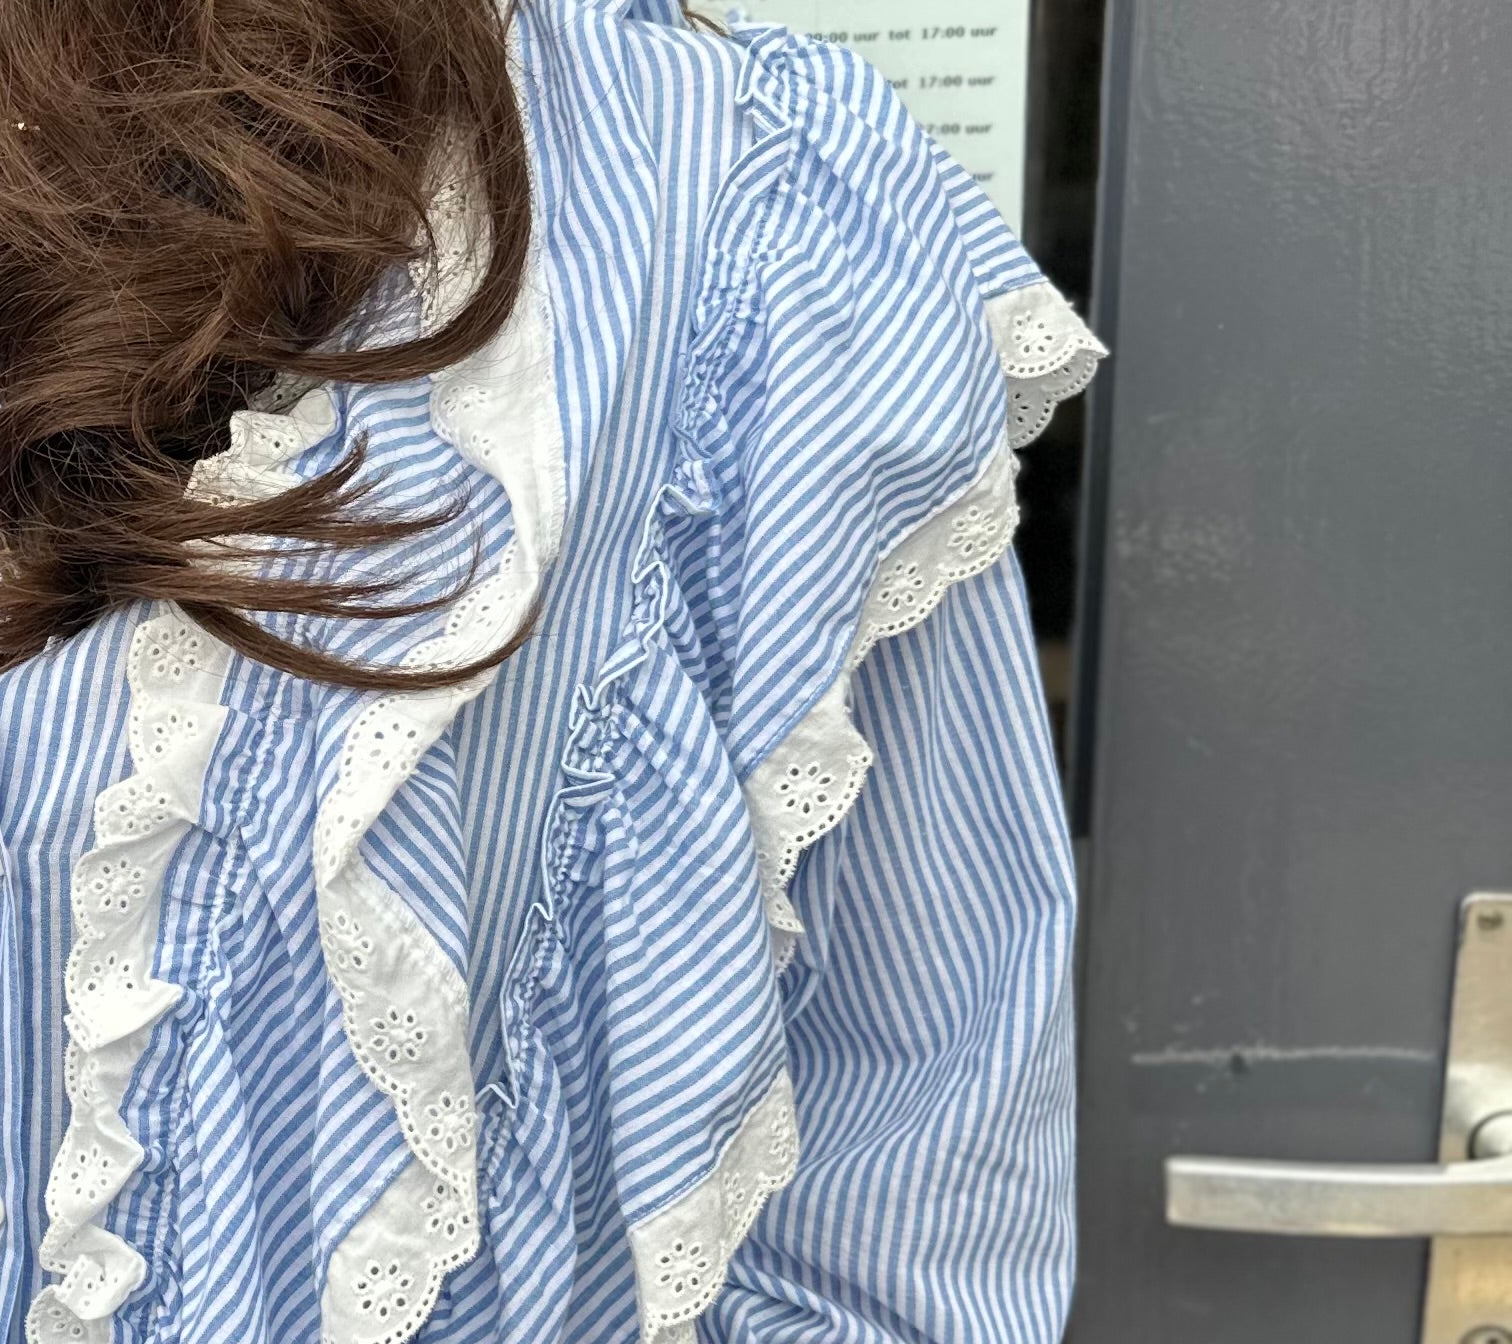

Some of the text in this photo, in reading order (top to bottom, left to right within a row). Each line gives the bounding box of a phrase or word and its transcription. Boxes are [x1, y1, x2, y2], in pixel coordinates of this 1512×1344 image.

[853, 31, 879, 43] uur
[888, 29, 911, 41] tot
[921, 27, 965, 40] 17:00
[970, 25, 998, 38] uur
[918, 76, 963, 90] 17:00
[968, 75, 995, 87] uur
[965, 123, 993, 135] uur
